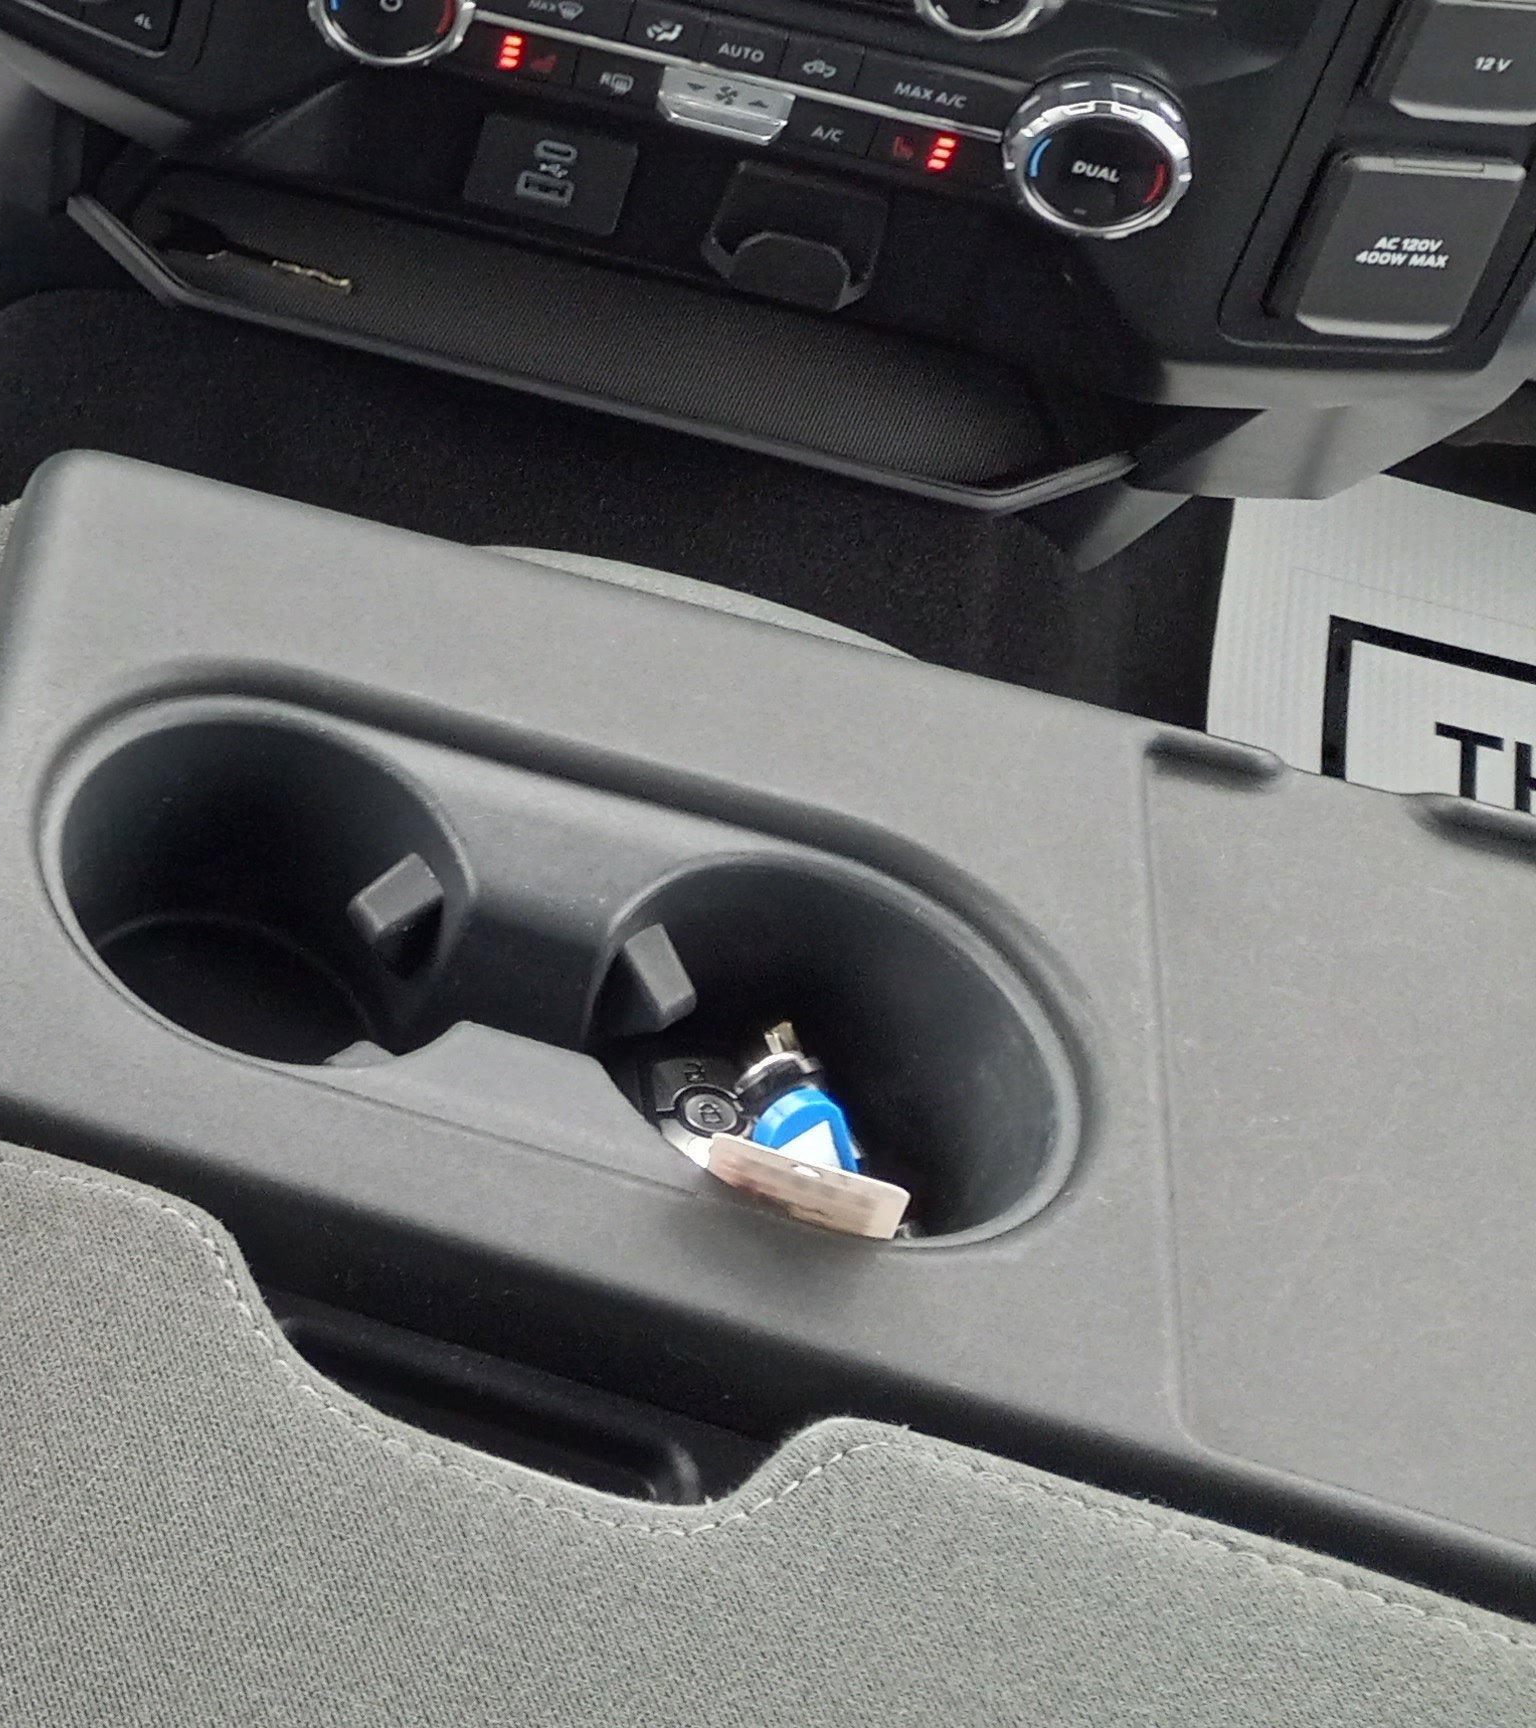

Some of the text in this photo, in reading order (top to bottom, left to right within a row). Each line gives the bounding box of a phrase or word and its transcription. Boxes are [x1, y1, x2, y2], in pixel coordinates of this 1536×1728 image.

[718, 41, 765, 64] AUTO
[893, 81, 968, 109] MAX A/C
[810, 125, 843, 145] A/C
[1071, 159, 1120, 184] DUAL
[1374, 236, 1443, 253] AC 120V
[1355, 250, 1449, 269] 400W MAX
